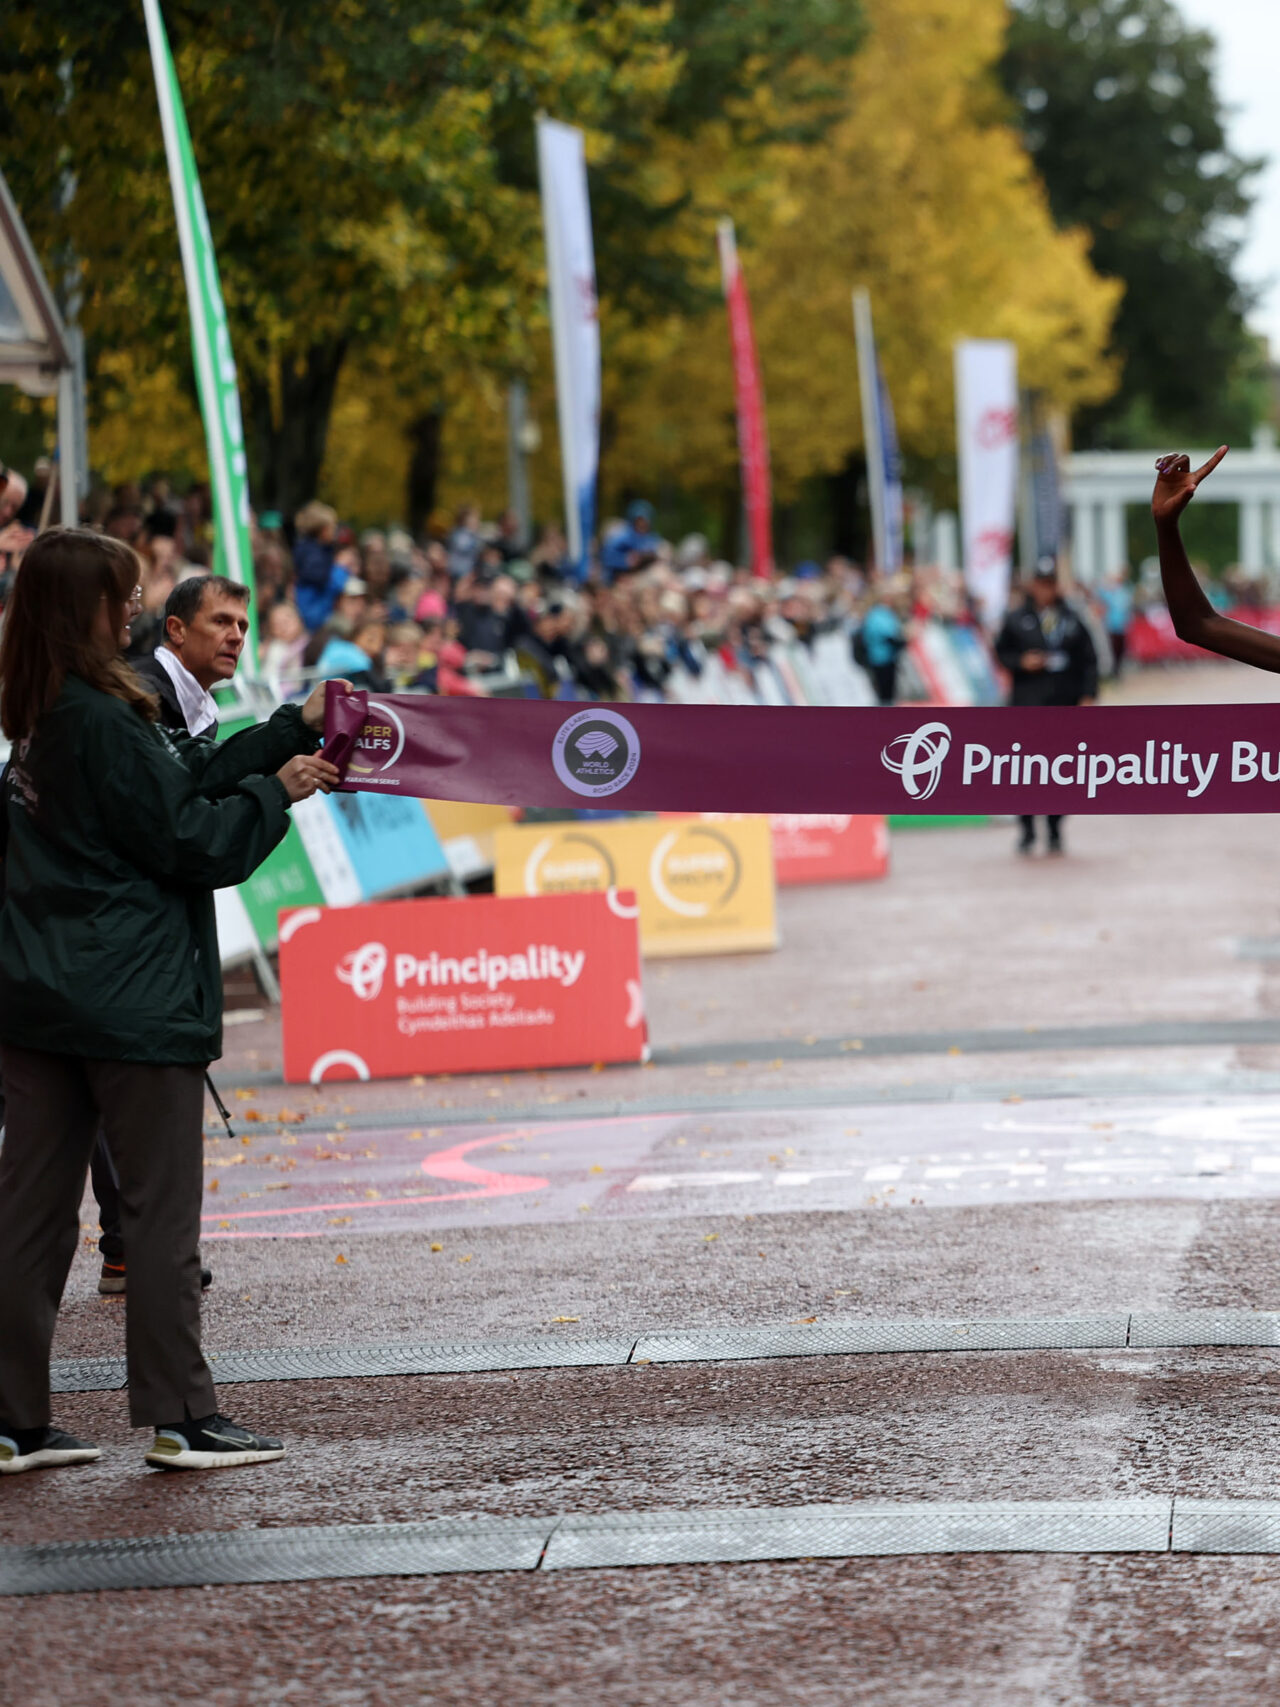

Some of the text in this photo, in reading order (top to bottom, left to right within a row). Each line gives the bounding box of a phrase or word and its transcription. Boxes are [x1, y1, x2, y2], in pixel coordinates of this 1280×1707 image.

[355, 738, 391, 750] ALFS
[364, 725, 392, 737] PER
[962, 740, 1219, 798] Principality
[395, 944, 586, 991] Principality
